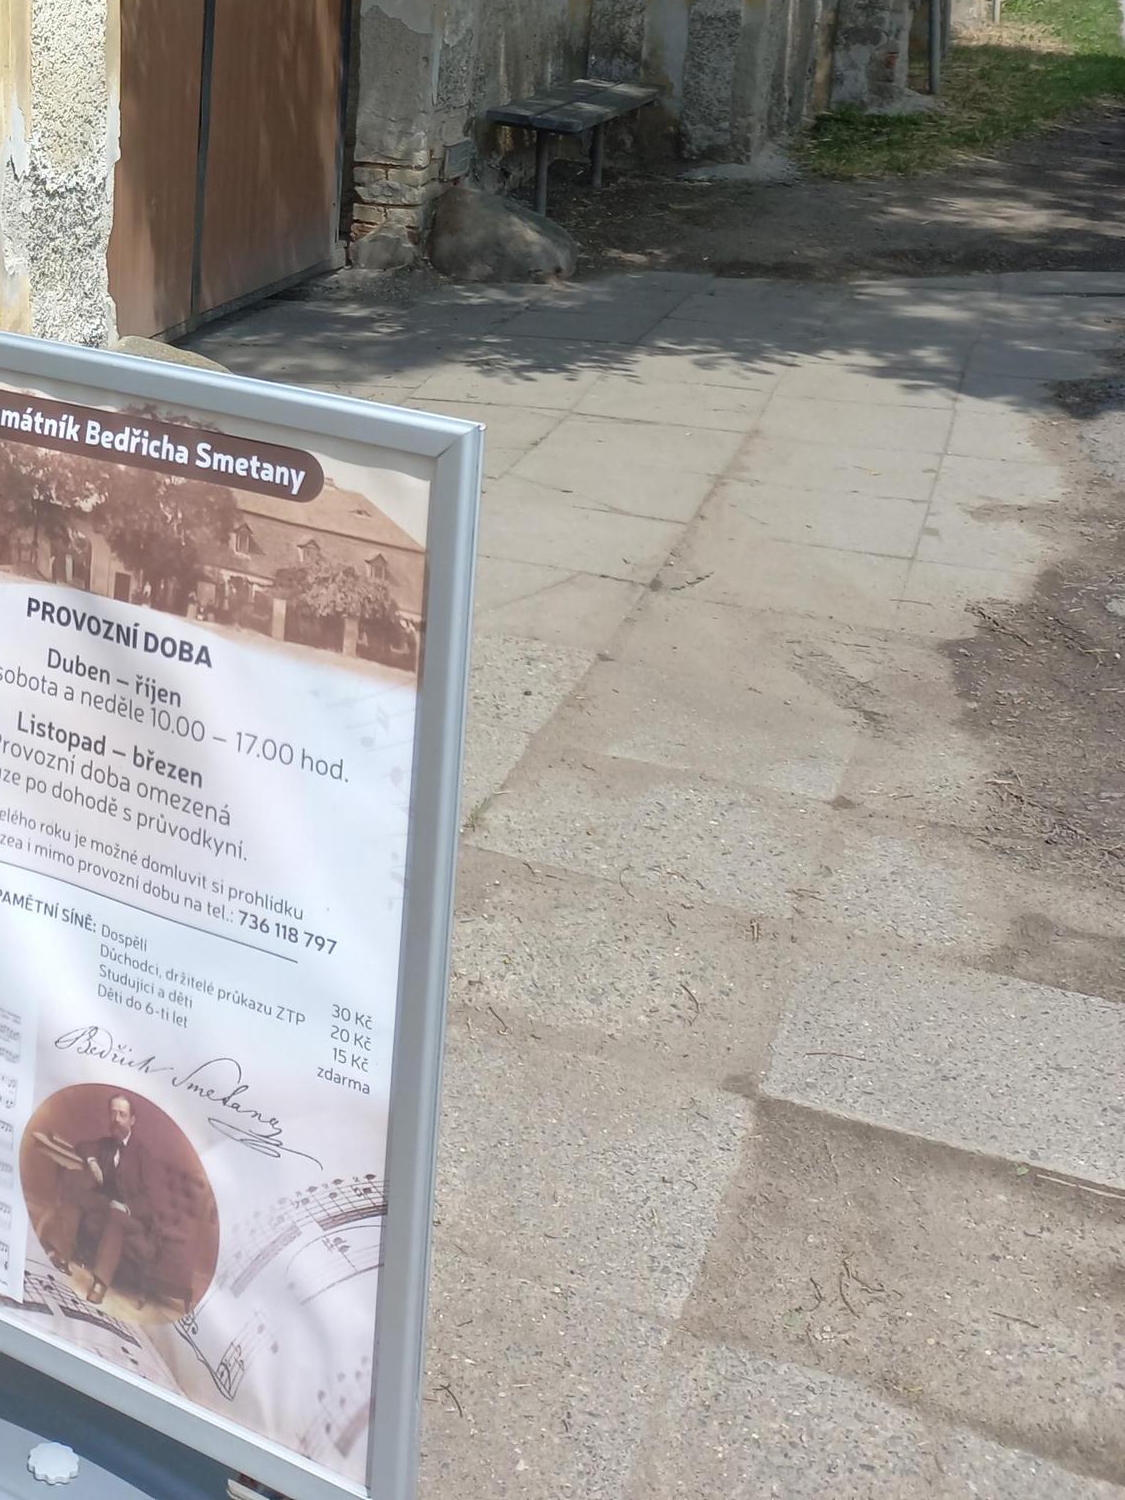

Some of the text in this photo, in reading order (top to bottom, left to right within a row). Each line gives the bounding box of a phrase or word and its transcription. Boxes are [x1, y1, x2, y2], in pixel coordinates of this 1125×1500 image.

[85, 420, 189, 465] Bedřicha
[195, 443, 307, 495] Smetany
[26, 596, 213, 669] PROVOZNÍ DOBA
[46, 646, 111, 685] Duben
[135, 673, 181, 708] říjen
[16, 710, 107, 757] Listopad
[132, 744, 203, 789] březen
[62, 684, 75, 702] a
[79, 689, 145, 724] neděle
[150, 706, 206, 742] 10.00
[236, 731, 294, 766] 17.00
[300, 747, 349, 783] hod.
[24, 775, 48, 794] po
[50, 779, 118, 818] dohodě
[122, 806, 132, 822] s
[136, 811, 248, 861] průvodkyní.
[79, 758, 131, 793] doba
[135, 781, 231, 827] omezená
[33, 843, 75, 867] mimo
[77, 858, 140, 891] provozní
[141, 878, 180, 905] dobu
[183, 895, 202, 912] na
[206, 900, 234, 923] tel.:
[237, 908, 270, 934] 736
[274, 921, 299, 944] 118
[302, 930, 338, 955] 797
[39, 821, 71, 842] roku
[73, 829, 87, 849] je
[89, 838, 138, 866] možné
[140, 853, 207, 890] domluvit
[211, 879, 224, 895] si
[227, 885, 304, 921] prohlídku
[60, 907, 97, 933] SÍNĚ:
[96, 982, 188, 1029] Děti do 6-ti let
[99, 942, 162, 979] Důchodci,
[216, 987, 272, 1016] průkazu
[275, 1004, 306, 1026] ZTP
[156, 987, 165, 999] a
[167, 988, 193, 1009] děti
[331, 1003, 373, 1031] 30 Kč
[329, 1024, 372, 1052] 20 Kč
[332, 1046, 369, 1073] 15 Kč
[316, 1066, 371, 1095] zdarma
